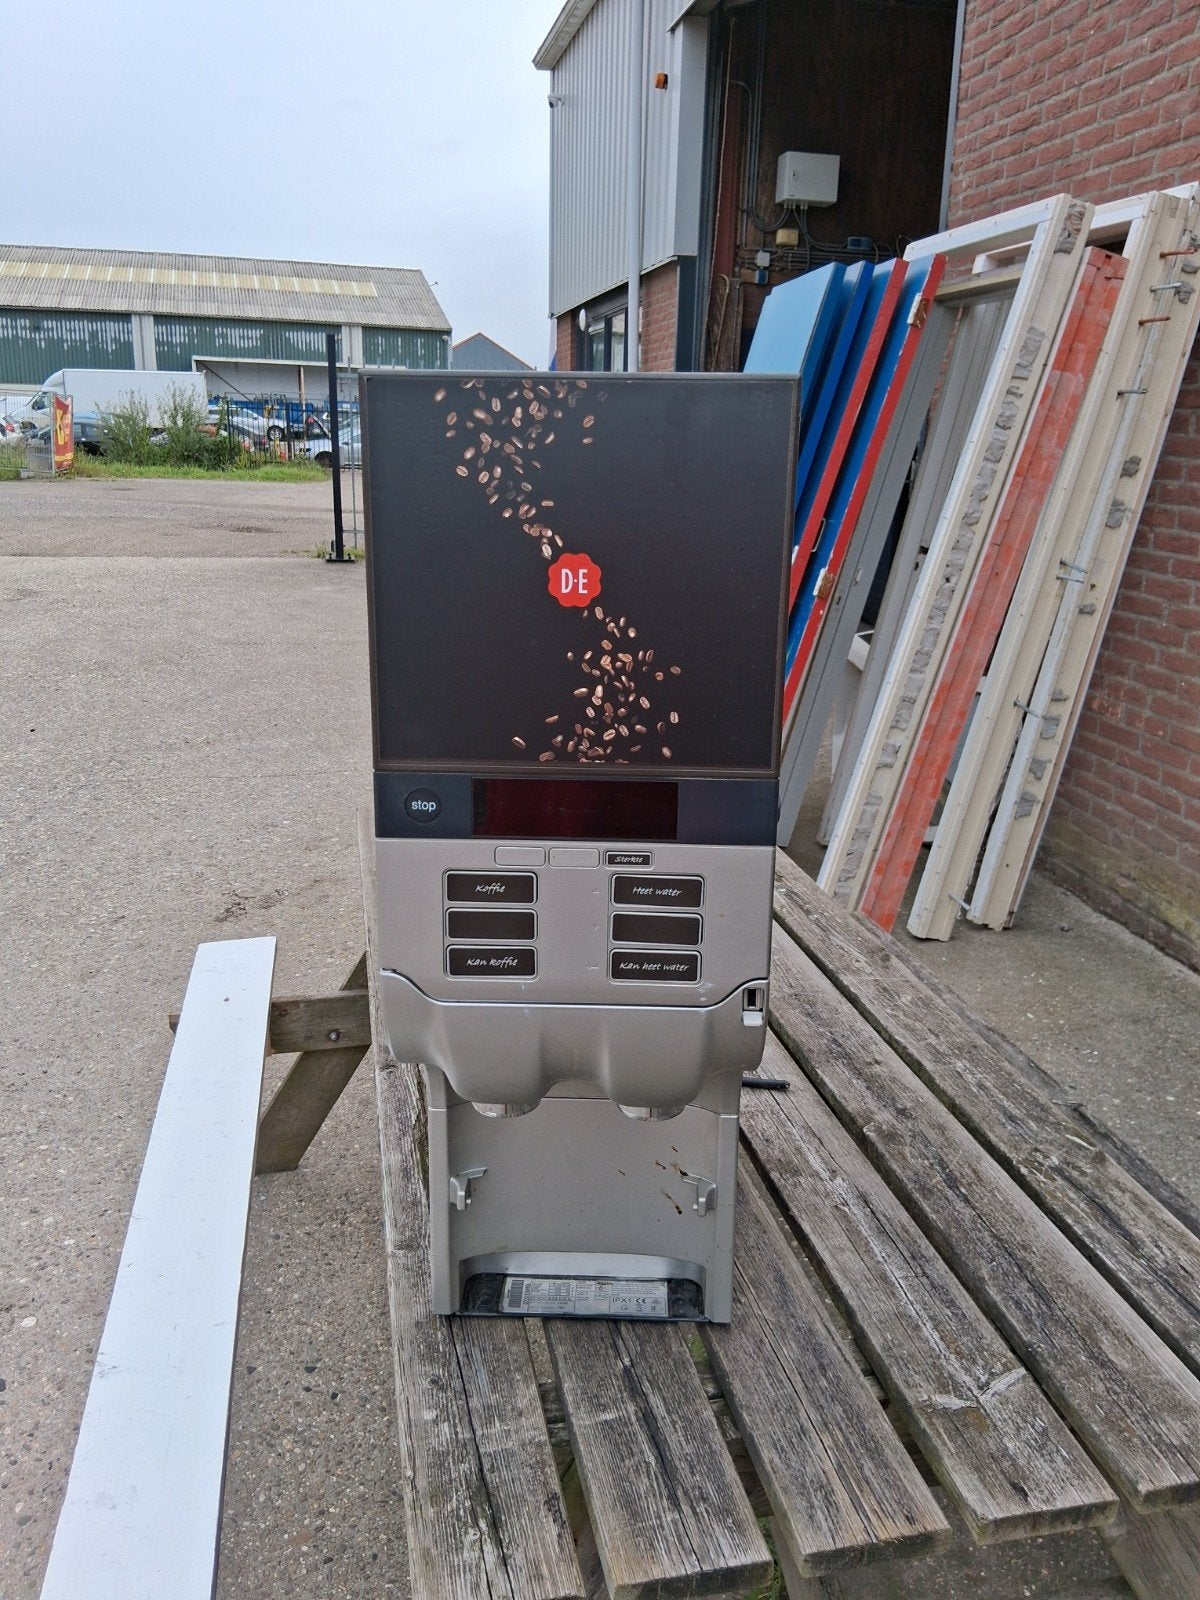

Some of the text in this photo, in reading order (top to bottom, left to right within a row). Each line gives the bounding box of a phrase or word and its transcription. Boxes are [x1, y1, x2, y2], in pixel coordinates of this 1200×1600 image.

[411, 799, 436, 813] stop
[614, 855, 643, 864] Sterkte
[475, 882, 506, 895] Koffie
[632, 886, 683, 897] Heet water
[466, 956, 518, 969] Kan koffie
[619, 961, 690, 972] Kan heet water
